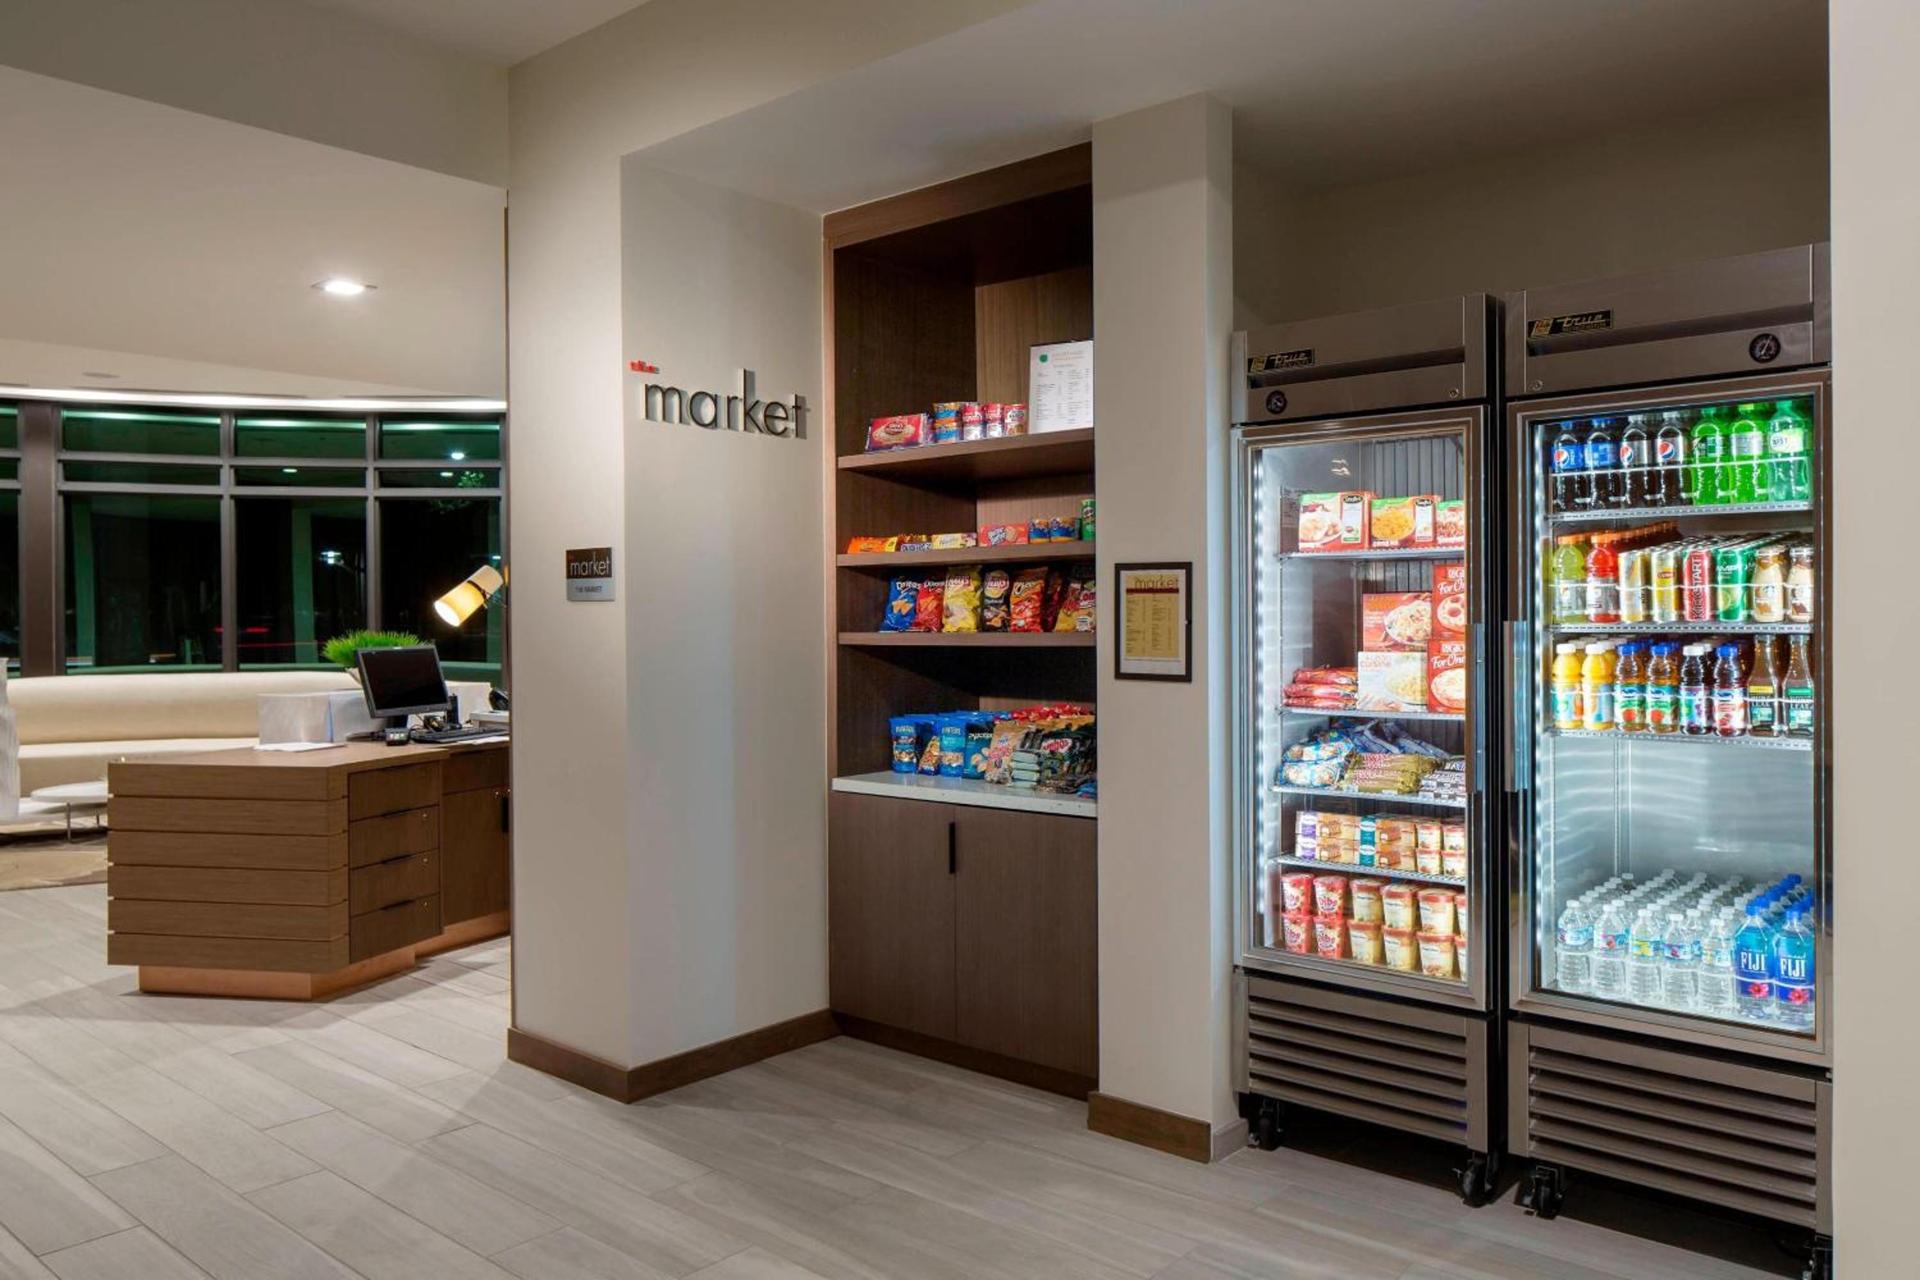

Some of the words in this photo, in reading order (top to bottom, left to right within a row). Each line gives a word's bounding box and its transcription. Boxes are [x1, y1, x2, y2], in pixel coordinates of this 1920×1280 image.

[644, 368, 804, 438] market
[570, 551, 610, 577] market
[1134, 574, 1179, 589] market
[1740, 951, 1767, 971] FIJI
[1780, 958, 1807, 978] FIJI
